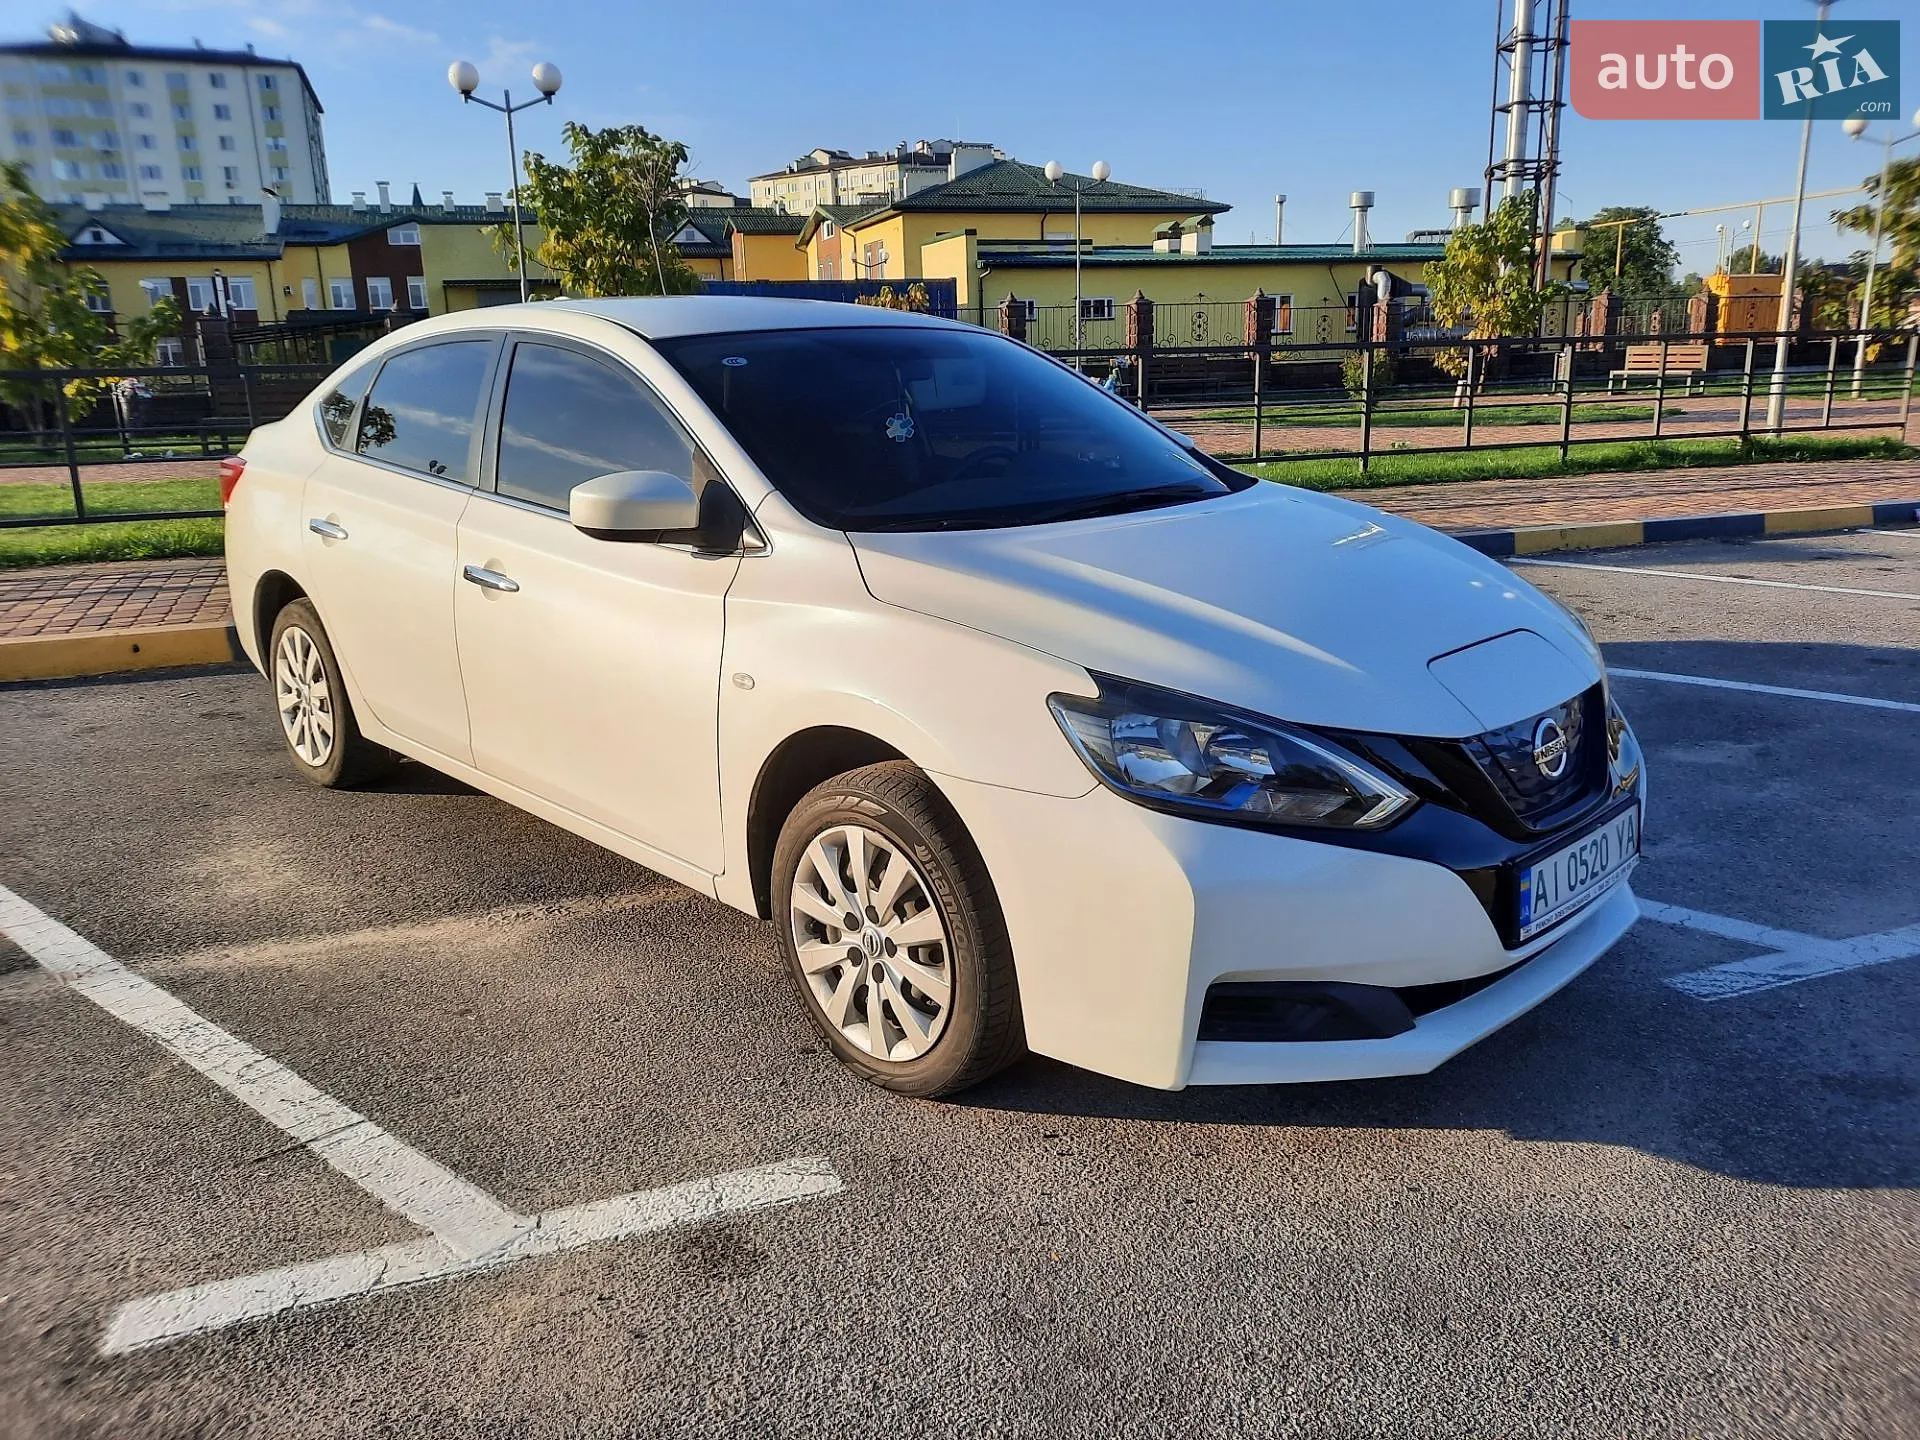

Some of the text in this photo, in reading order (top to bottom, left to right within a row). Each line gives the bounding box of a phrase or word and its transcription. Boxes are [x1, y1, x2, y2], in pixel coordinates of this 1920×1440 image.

[1566, 832, 1609, 893] 0520
[1616, 814, 1635, 860] YA
[924, 859, 973, 970] Hankoo
